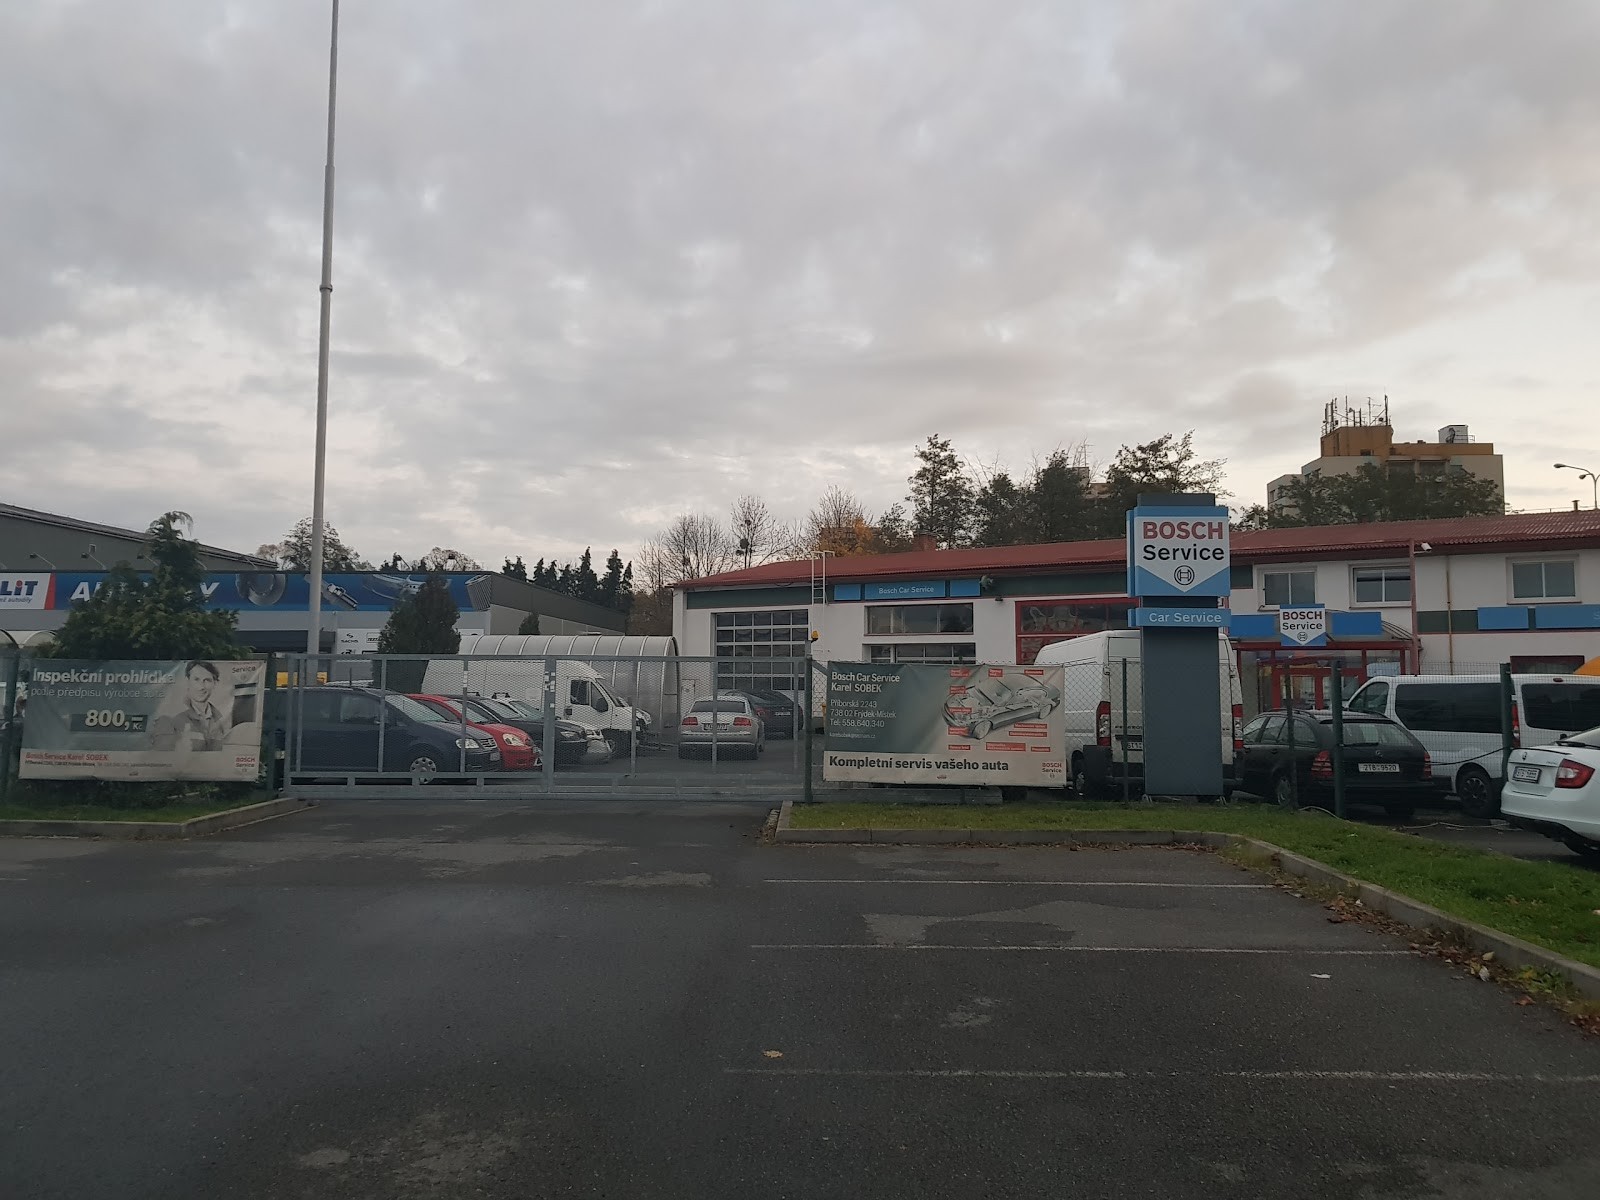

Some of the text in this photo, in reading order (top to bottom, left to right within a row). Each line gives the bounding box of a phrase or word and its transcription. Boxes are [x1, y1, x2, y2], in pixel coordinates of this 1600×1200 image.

[1142, 521, 1224, 540] BOSCH
[1142, 544, 1225, 561] Service
[1149, 612, 1222, 622] Car Service
[1282, 611, 1323, 621] BOSCH
[1282, 621, 1323, 630] Service
[33, 668, 176, 685] Inspekční prohlídka
[831, 671, 900, 682] Bosch Car Service
[831, 682, 882, 692] Karel SOBEK
[31, 687, 55, 697] podle
[57, 687, 101, 698] předpisu
[104, 687, 140, 698] výrobce
[860, 700, 878, 708] 2243
[830, 709, 843, 717] 738
[844, 709, 853, 717] 02
[86, 753, 108, 761] SOBEK
[829, 755, 1009, 771] Kompletní servis vašeho auta
